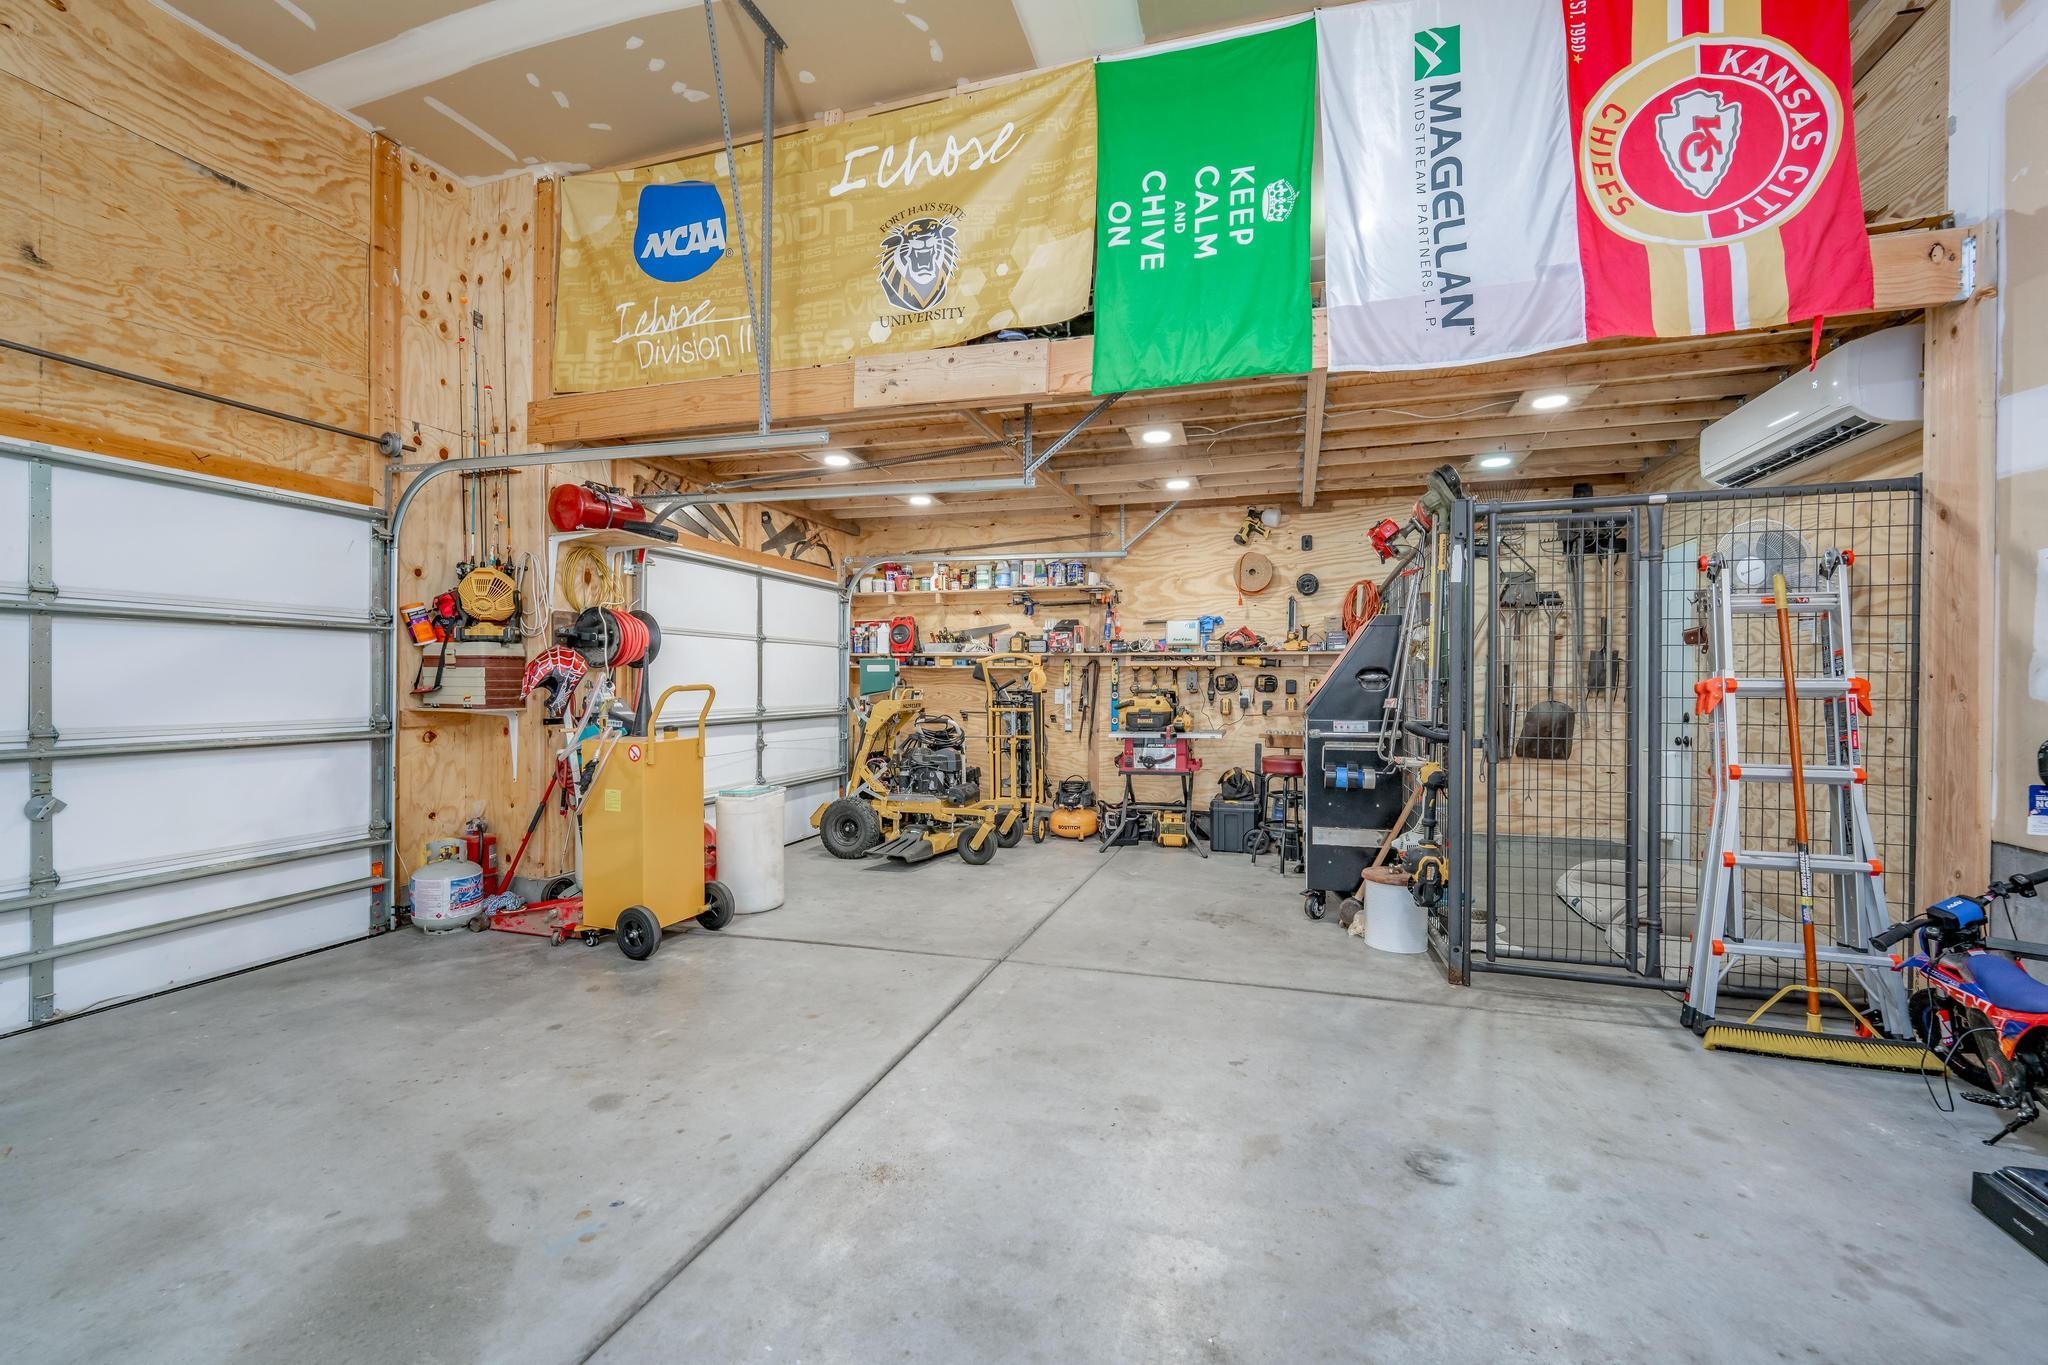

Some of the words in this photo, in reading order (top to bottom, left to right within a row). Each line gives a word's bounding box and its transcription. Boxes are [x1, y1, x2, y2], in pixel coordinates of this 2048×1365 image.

[1570, 0, 1586, 18] ST.
[1570, 22, 1586, 52] 1960
[1718, 48, 1823, 151] KANSAS
[877, 122, 1025, 188] chose
[1591, 103, 1635, 216] CHIEFS
[1679, 114, 1723, 173] KC
[879, 209, 906, 233] FORT
[907, 202, 936, 215] HAYS
[938, 202, 967, 221] STATE
[1107, 201, 1132, 248] ON
[1140, 170, 1167, 271] CHIVE
[1174, 200, 1186, 234] AND
[1194, 166, 1220, 259] CALM
[1229, 165, 1256, 245] KEEP
[1414, 87, 1427, 194] MIDSTREAM
[1424, 299, 1437, 331] L.P.
[1430, 81, 1474, 328] MAGELLAN
[1733, 164, 1809, 229] CITY
[641, 217, 726, 258] NCAA
[879, 306, 966, 328] UNIVERSITY
[637, 333, 730, 369] Division
